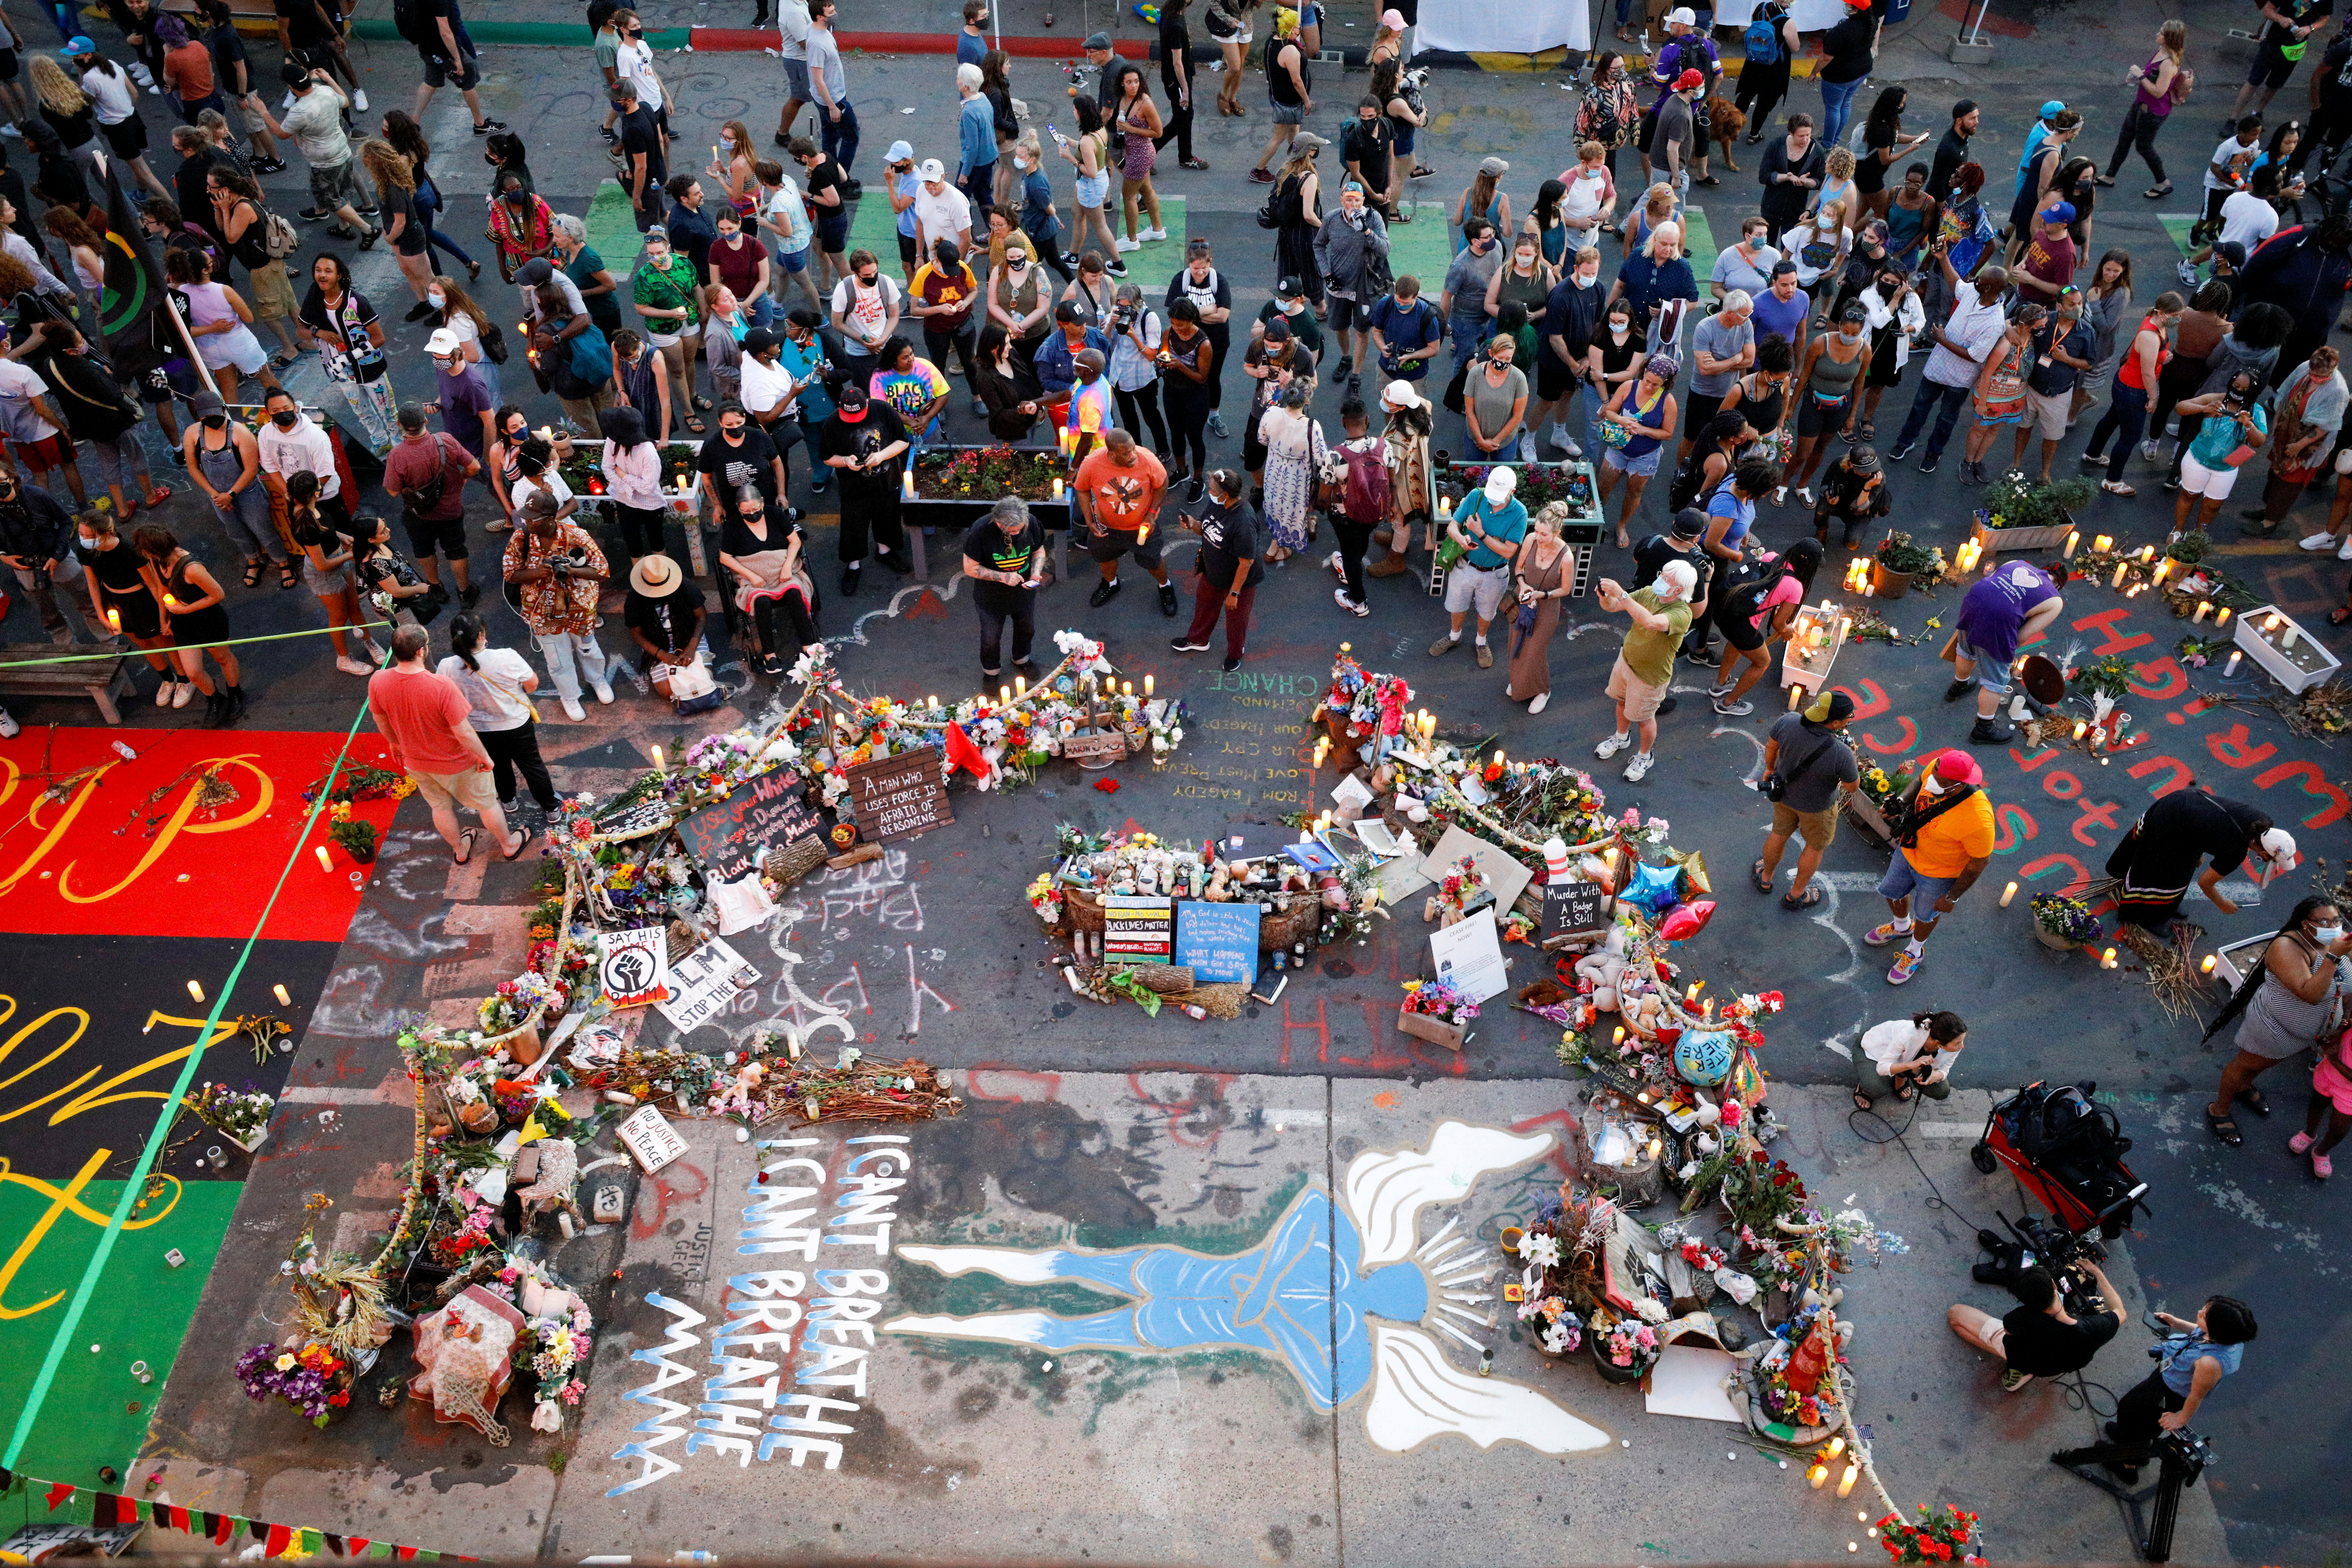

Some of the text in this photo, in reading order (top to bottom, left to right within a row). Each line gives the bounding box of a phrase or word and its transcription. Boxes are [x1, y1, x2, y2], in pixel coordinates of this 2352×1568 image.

[2030, 241, 2051, 265] STAFF
[939, 286, 961, 303] M
[887, 382, 927, 397] BLACK
[752, 771, 798, 802] White
[879, 776, 899, 793] MAN
[901, 771, 922, 785] WHO
[865, 785, 937, 811] USES FORCE IS
[881, 799, 934, 824] AFRAID OF
[784, 812, 821, 840] Matter
[717, 846, 738, 861] the
[706, 855, 752, 884] Black
[1547, 884, 1600, 901] Murder With
[1561, 901, 1593, 915] A Badge
[1106, 920, 1168, 931] BLACK LIVES MATTER
[1181, 909, 1196, 920] My
[1243, 918, 1256, 929] save
[1220, 921, 1229, 929] and
[1449, 921, 1477, 937] CEASE FIRE!
[1560, 912, 1593, 927] Is Still
[608, 928, 661, 944] SAY HIS
[1217, 929, 1237, 939] anything
[1238, 933, 1250, 942] that
[1458, 932, 1472, 942] NOW!
[609, 940, 657, 958] NAME!
[1185, 949, 1245, 961] WHAT HAPPENS
[1215, 968, 1234, 977] MOVE
[611, 986, 657, 1008] BLM
[668, 960, 741, 1016] now forever
[679, 999, 710, 1026] STOP
[707, 981, 735, 1004] THE
[640, 1109, 683, 1158] NO JUSTICE,
[635, 1132, 664, 1166] PEACE
[686, 1221, 713, 1289] JUSTICE
[686, 1138, 826, 1468] I CANT BREATHE
[757, 1135, 911, 1471] I CANT BREATHE
[605, 1291, 706, 1497] MAMA
